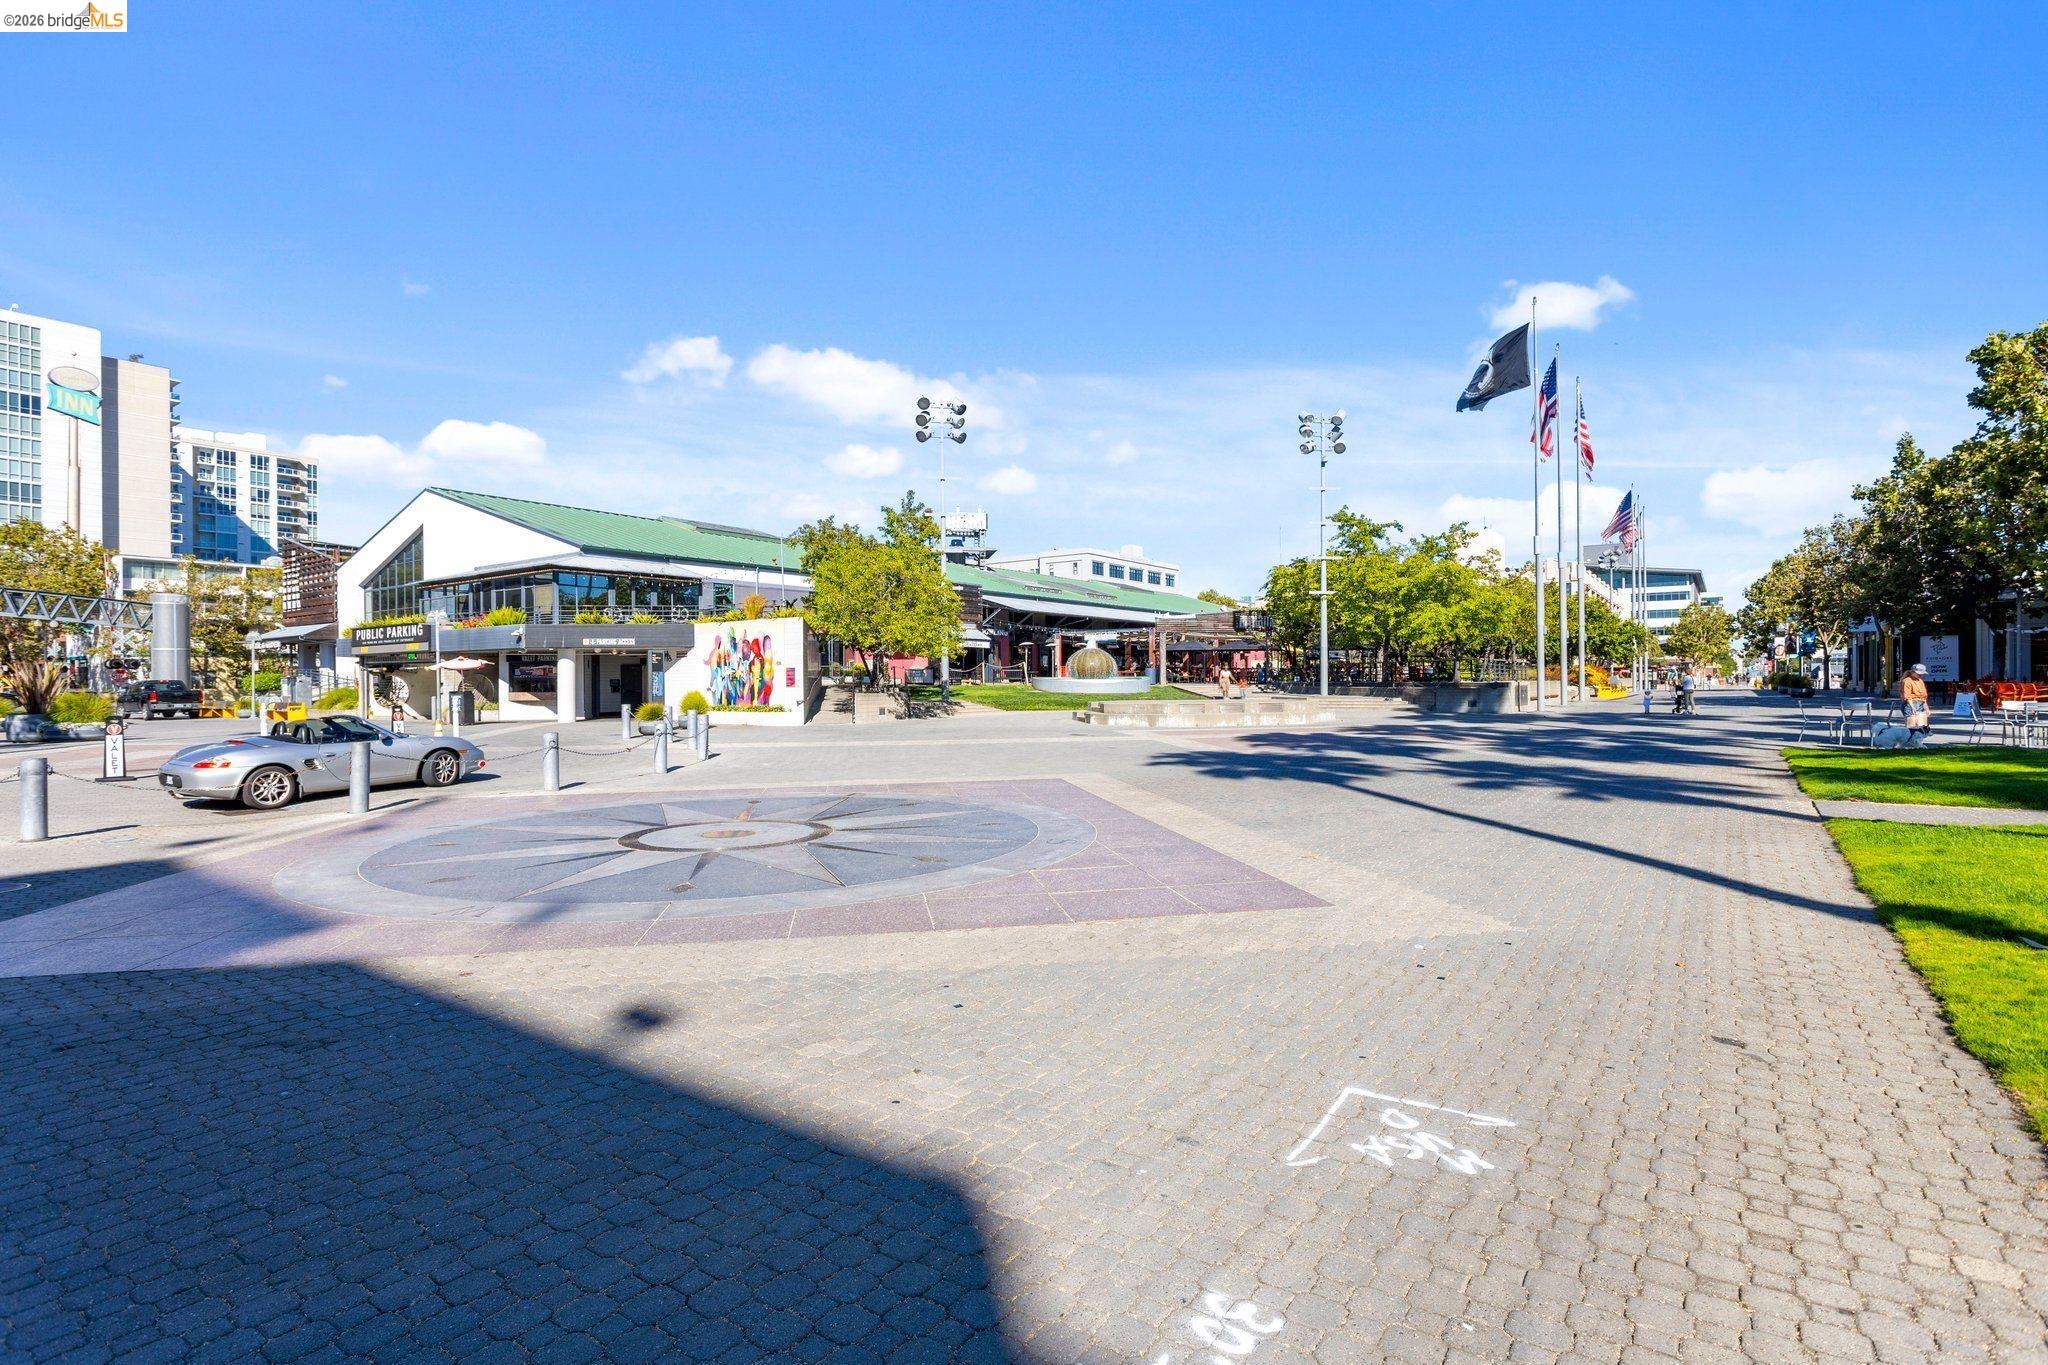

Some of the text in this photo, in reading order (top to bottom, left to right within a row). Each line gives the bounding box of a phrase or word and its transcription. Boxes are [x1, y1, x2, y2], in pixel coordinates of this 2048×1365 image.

[56, 388, 94, 416] INN
[355, 627, 384, 641] PUBLIC
[386, 623, 424, 639] PARKING
[110, 737, 119, 774] VALET
